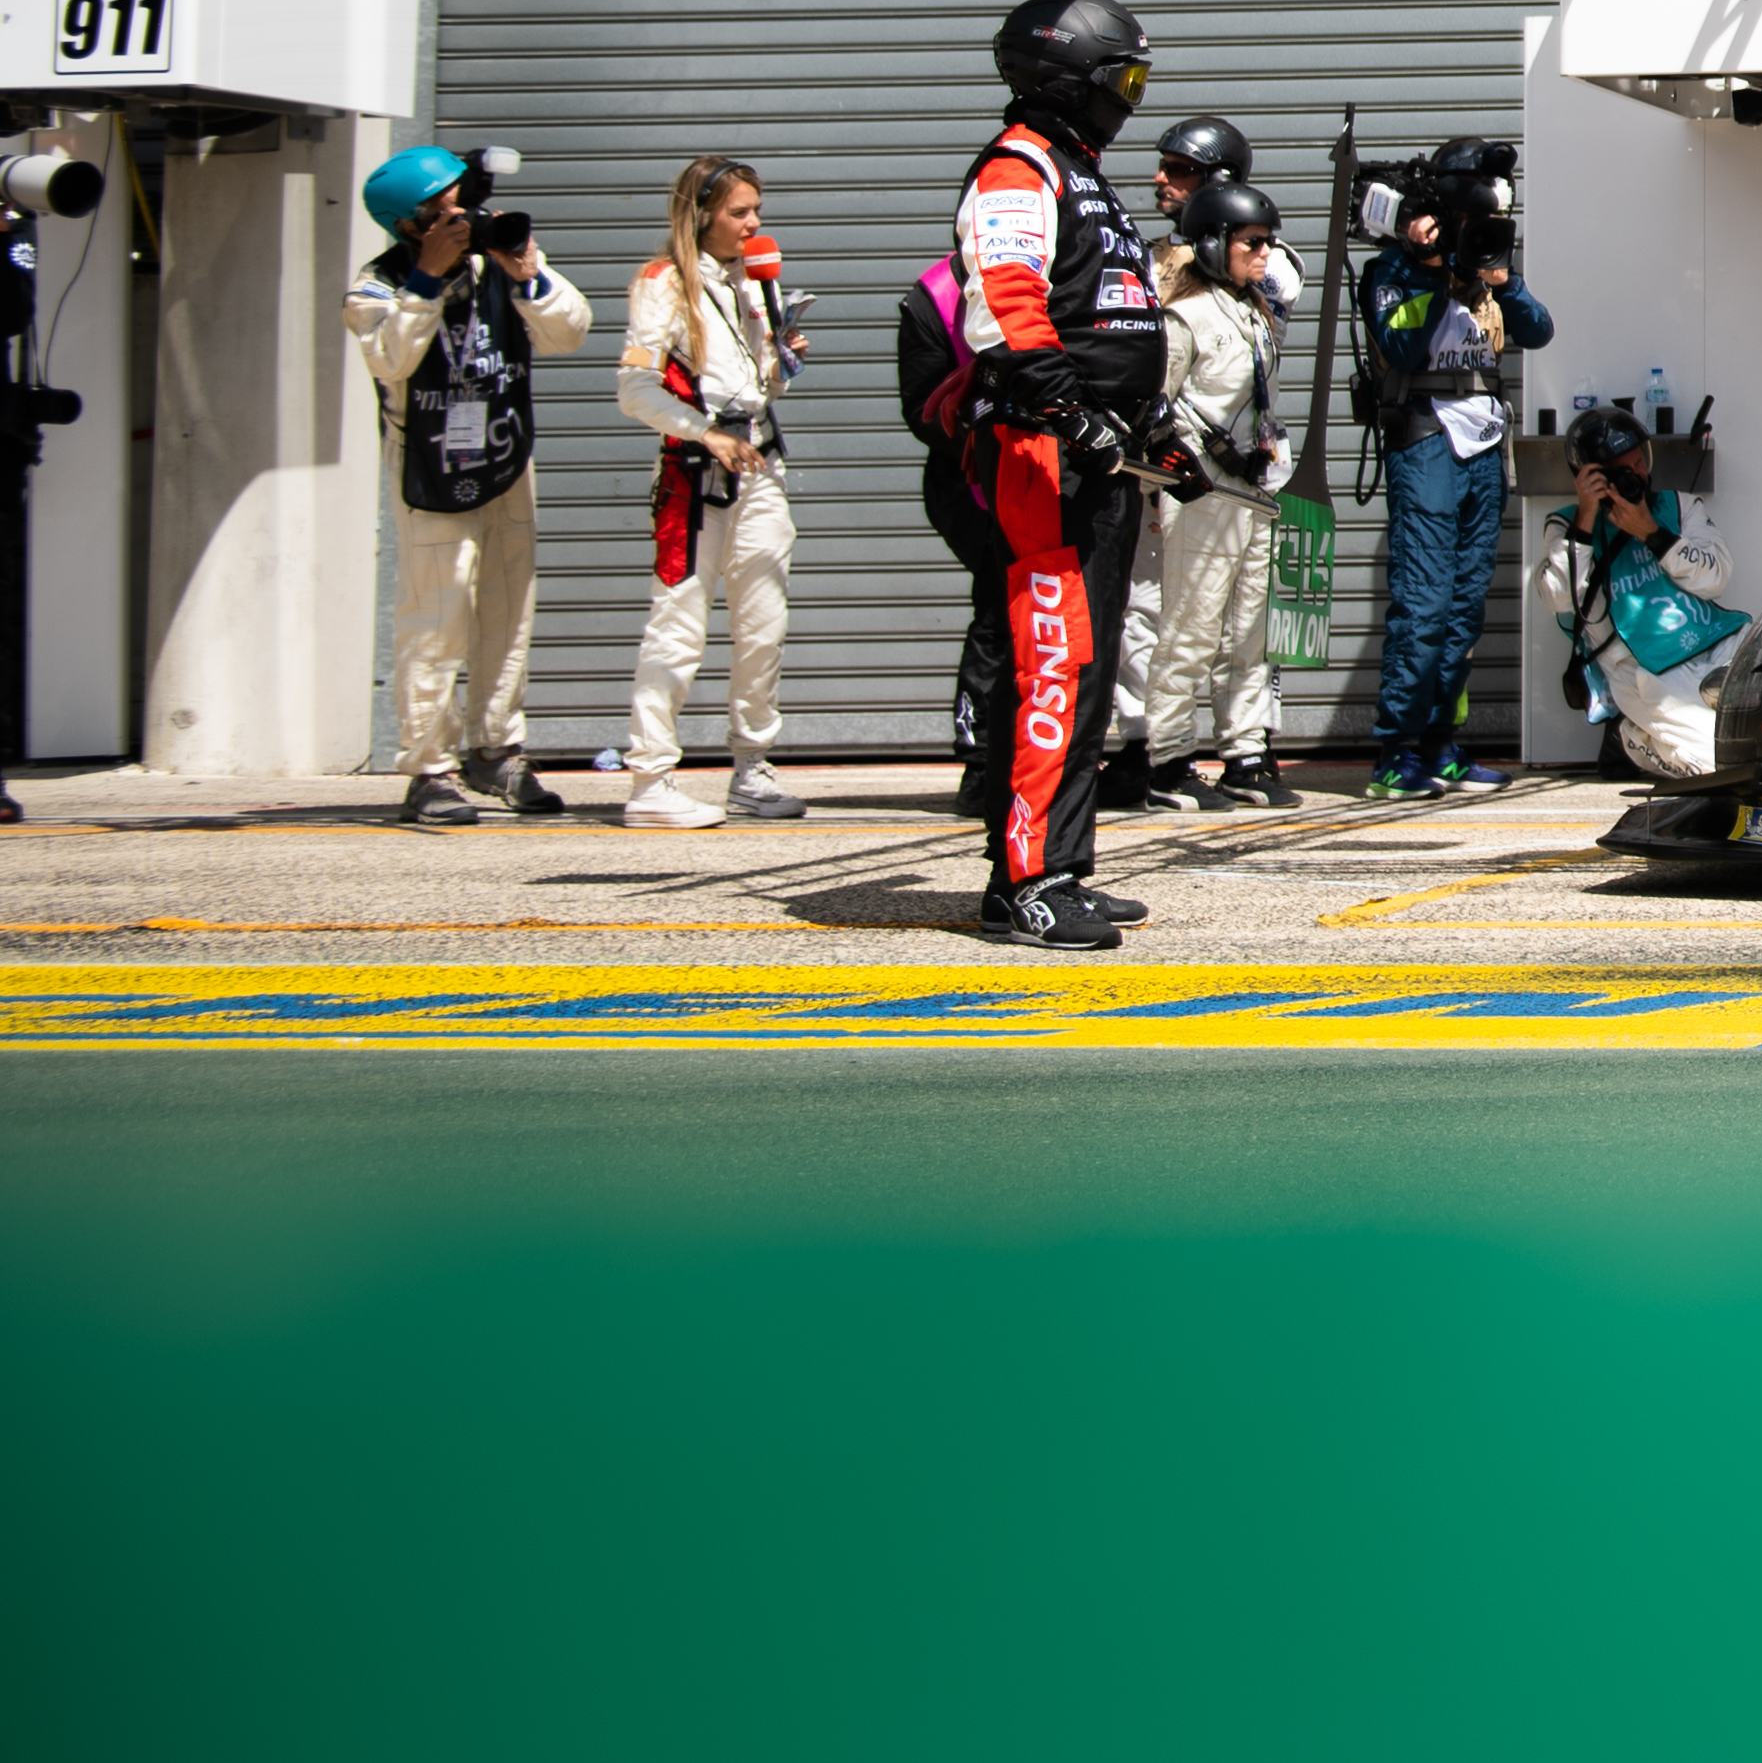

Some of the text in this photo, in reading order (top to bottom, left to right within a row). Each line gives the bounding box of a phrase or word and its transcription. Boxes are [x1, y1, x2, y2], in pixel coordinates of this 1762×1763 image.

[1094, 319, 1156, 331] RACING
[1267, 608, 1330, 659] DRV ON
[1027, 571, 1068, 750] DENSO
